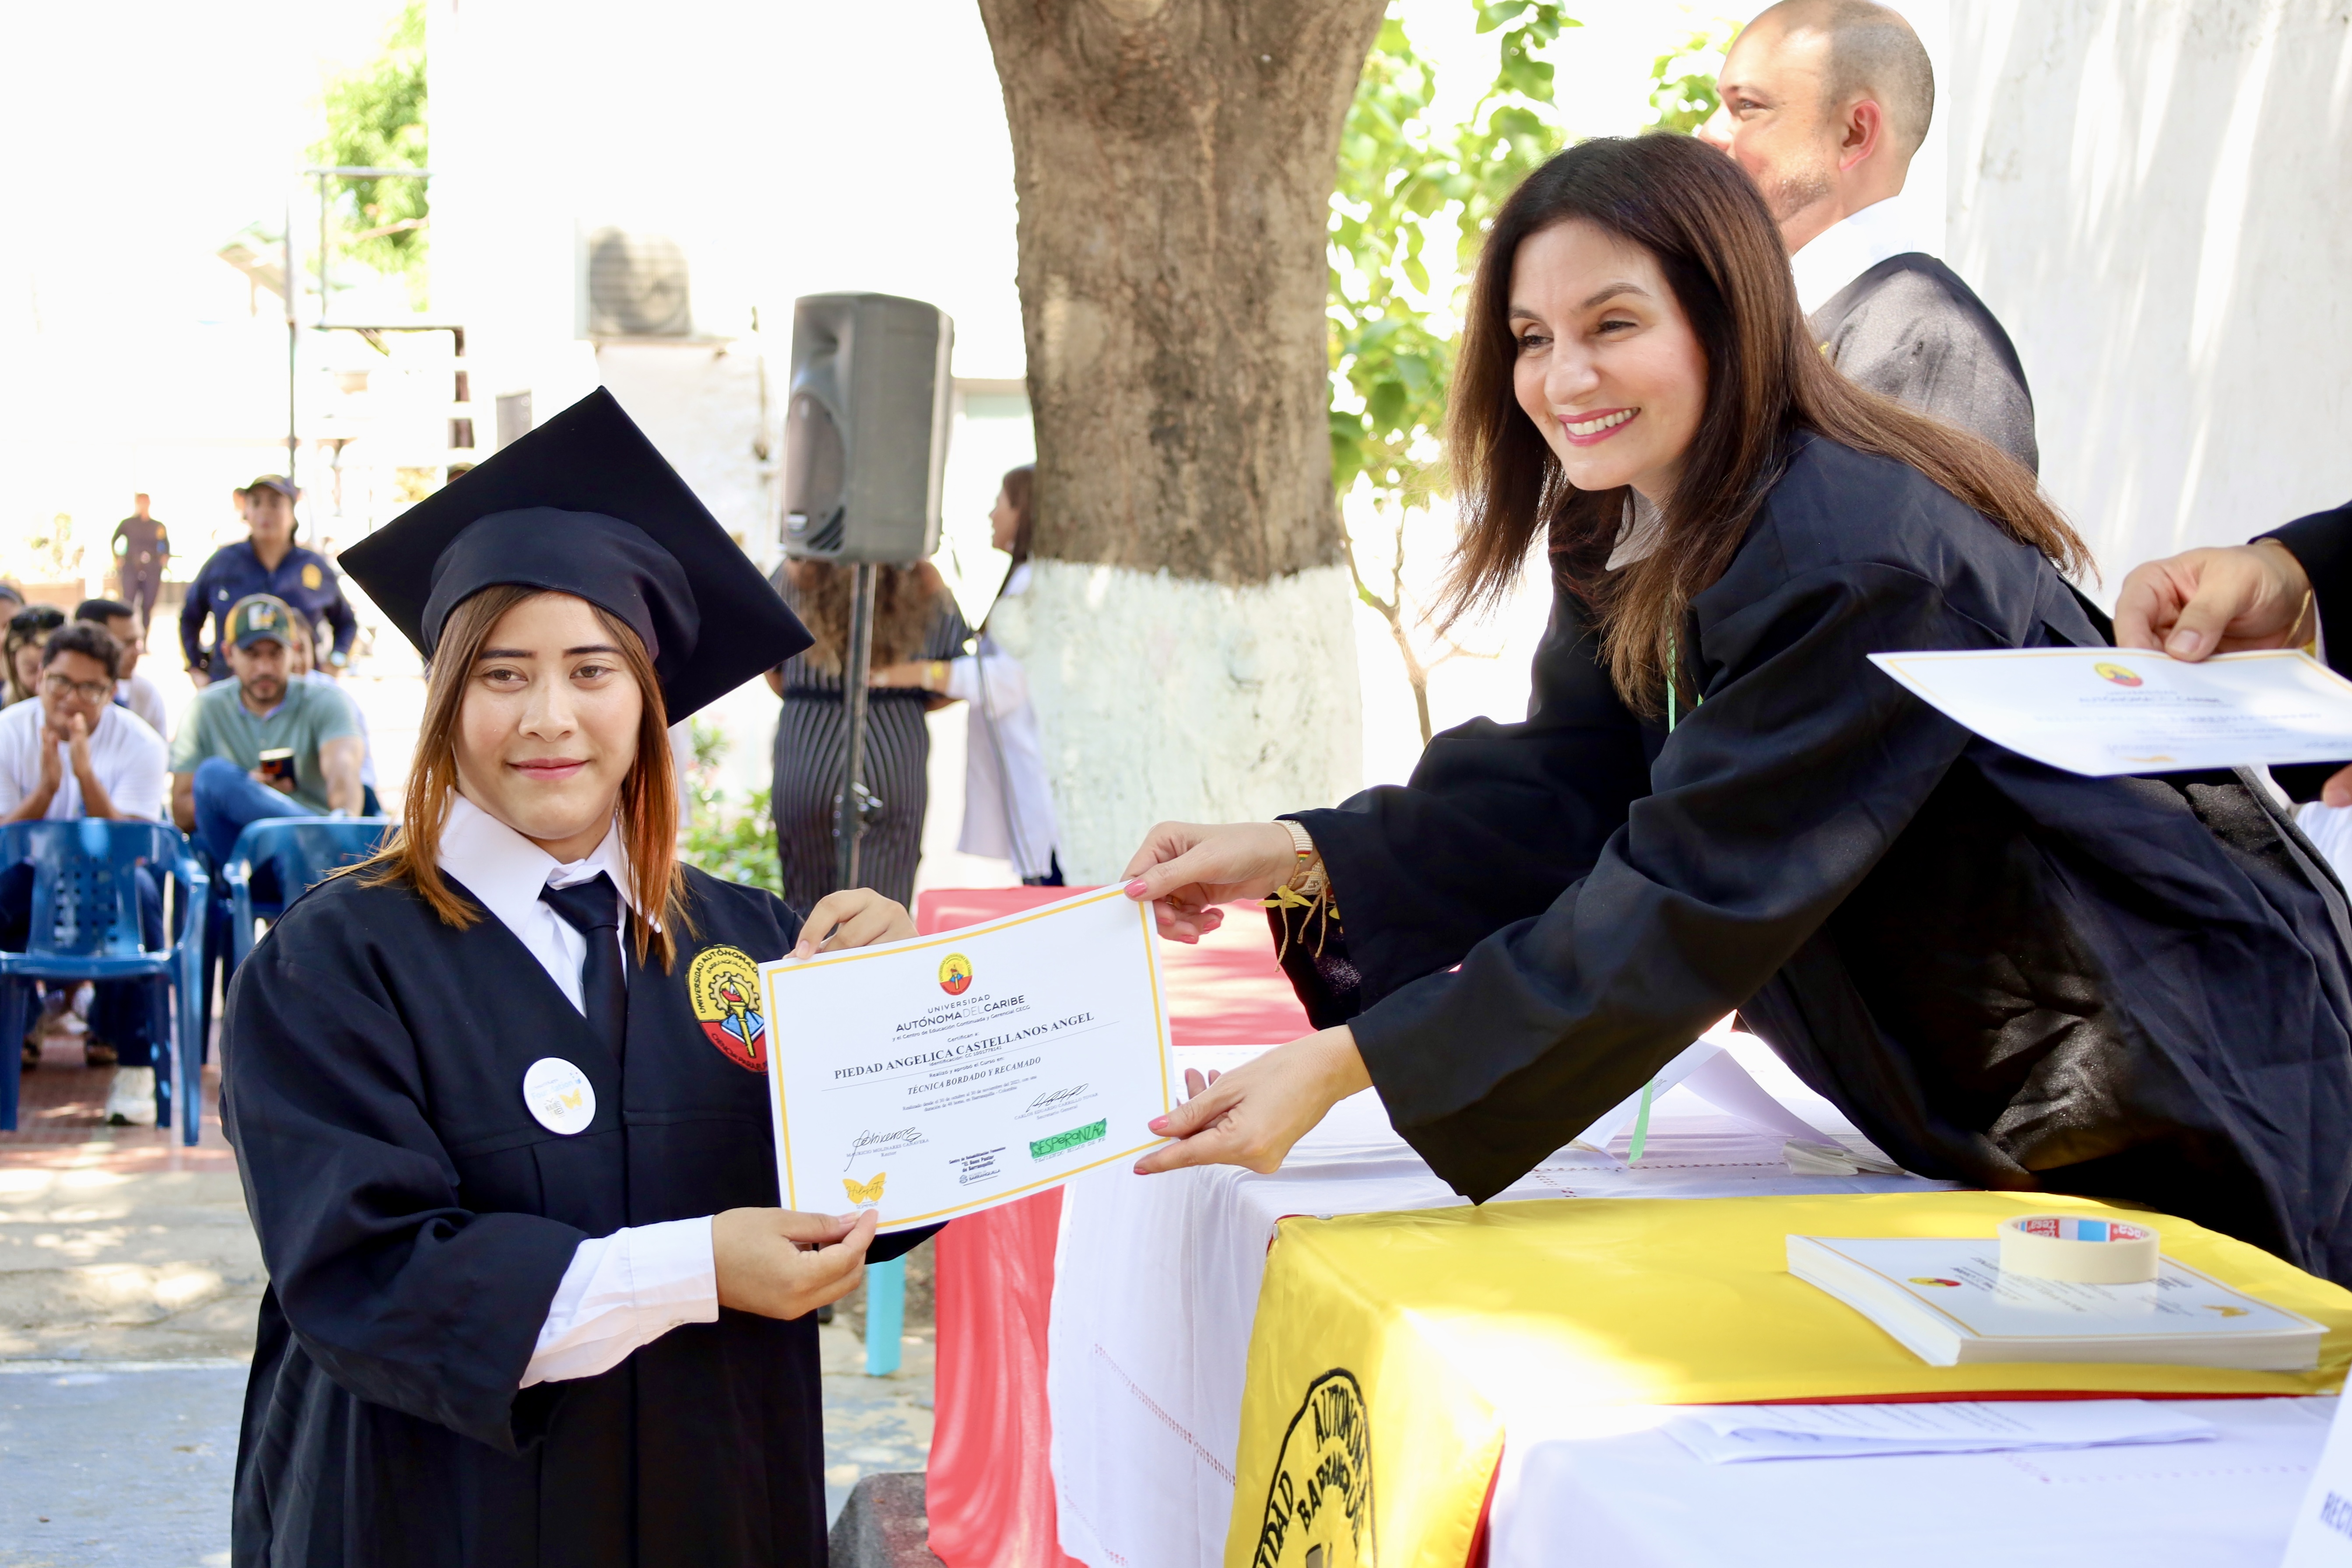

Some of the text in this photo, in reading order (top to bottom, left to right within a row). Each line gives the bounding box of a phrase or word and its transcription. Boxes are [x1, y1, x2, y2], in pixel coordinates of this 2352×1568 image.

[694, 961, 706, 1014] UNIVERSIDAD
[928, 994, 990, 1014] UNIVERSIDAD
[929, 1024, 955, 1034] Educación
[956, 1017, 986, 1027] Continuada
[990, 1009, 1015, 1019] Gerencial
[834, 1012, 1095, 1080] PIEDAD ANGELICA CASTELLANOS ANGEL
[947, 1033, 973, 1043] Certifican
[908, 1081, 944, 1095] TÉCNICA
[946, 1071, 986, 1087] BORDADO
[994, 1056, 1041, 1075] RECAMADO
[929, 1069, 948, 1078] Realizó
[954, 1064, 973, 1073] aprobó
